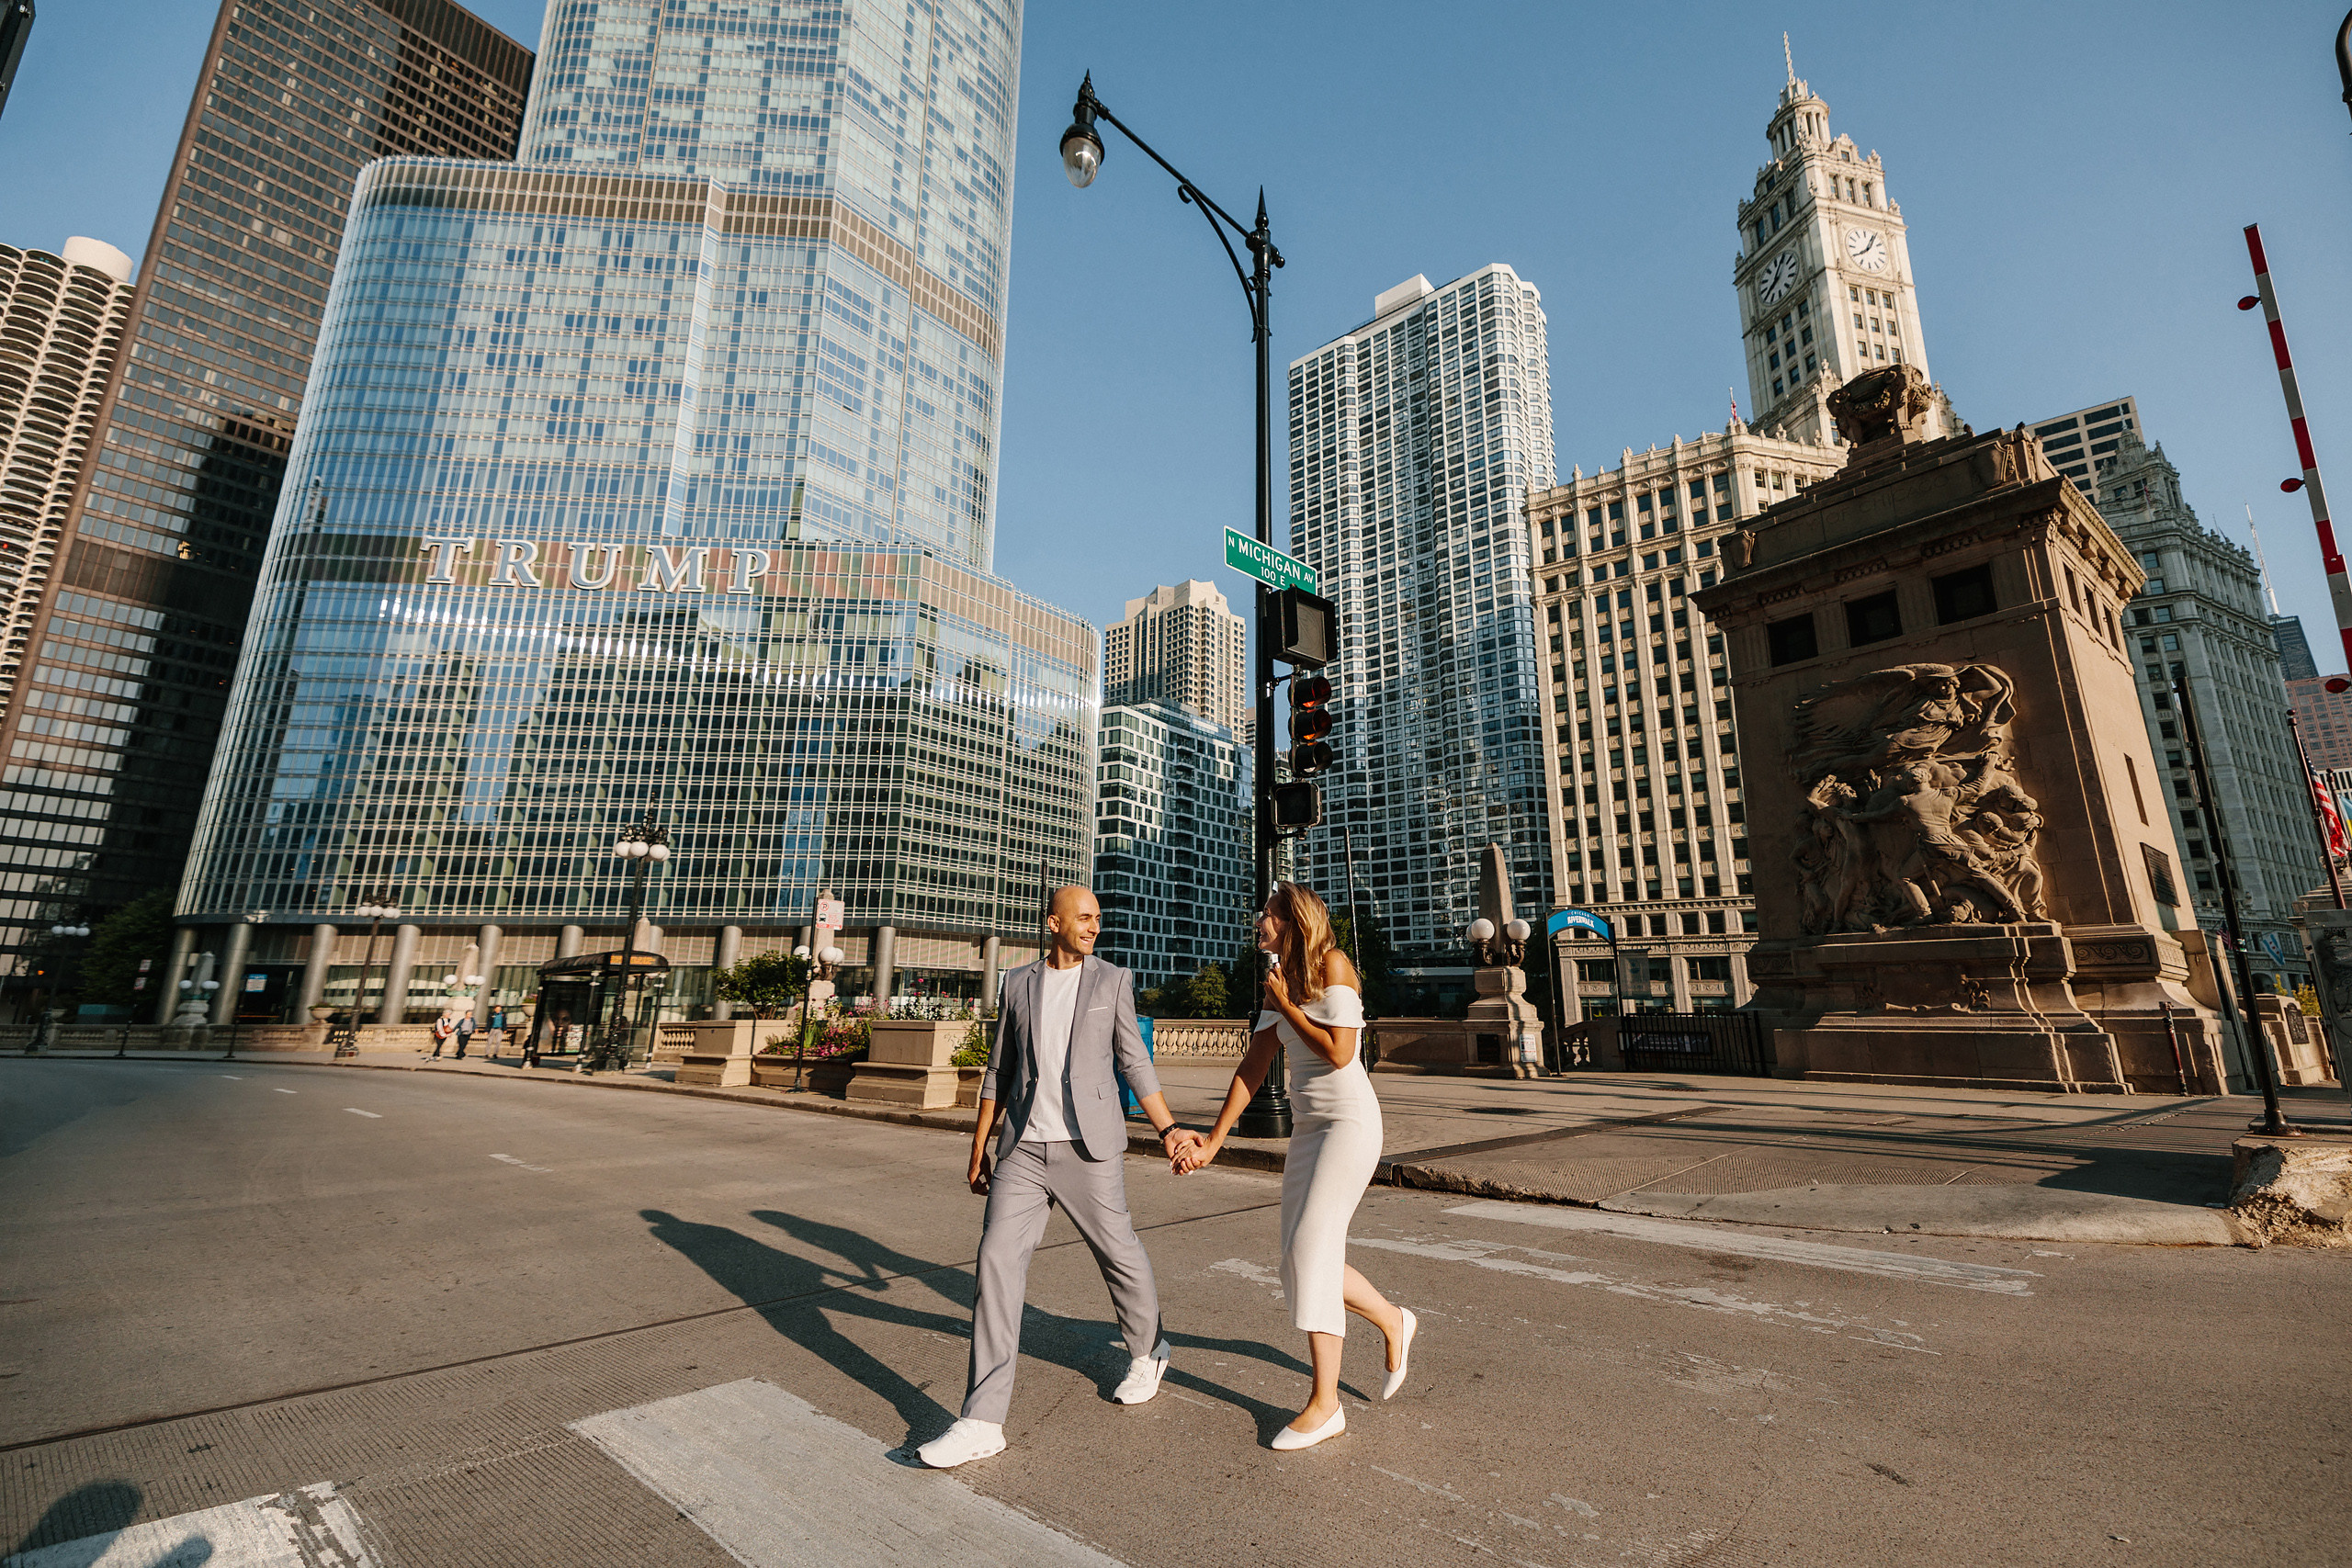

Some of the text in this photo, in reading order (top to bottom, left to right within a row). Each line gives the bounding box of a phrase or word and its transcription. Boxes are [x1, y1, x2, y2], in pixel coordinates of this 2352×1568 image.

[1859, 474, 1949, 513] CHICAGO
[419, 535, 772, 595] TRUMP
[1227, 535, 1314, 584] N MICHIGAN AV
[1261, 566, 1286, 587] 100 E
[1567, 916, 1595, 928] RIVERWALK
